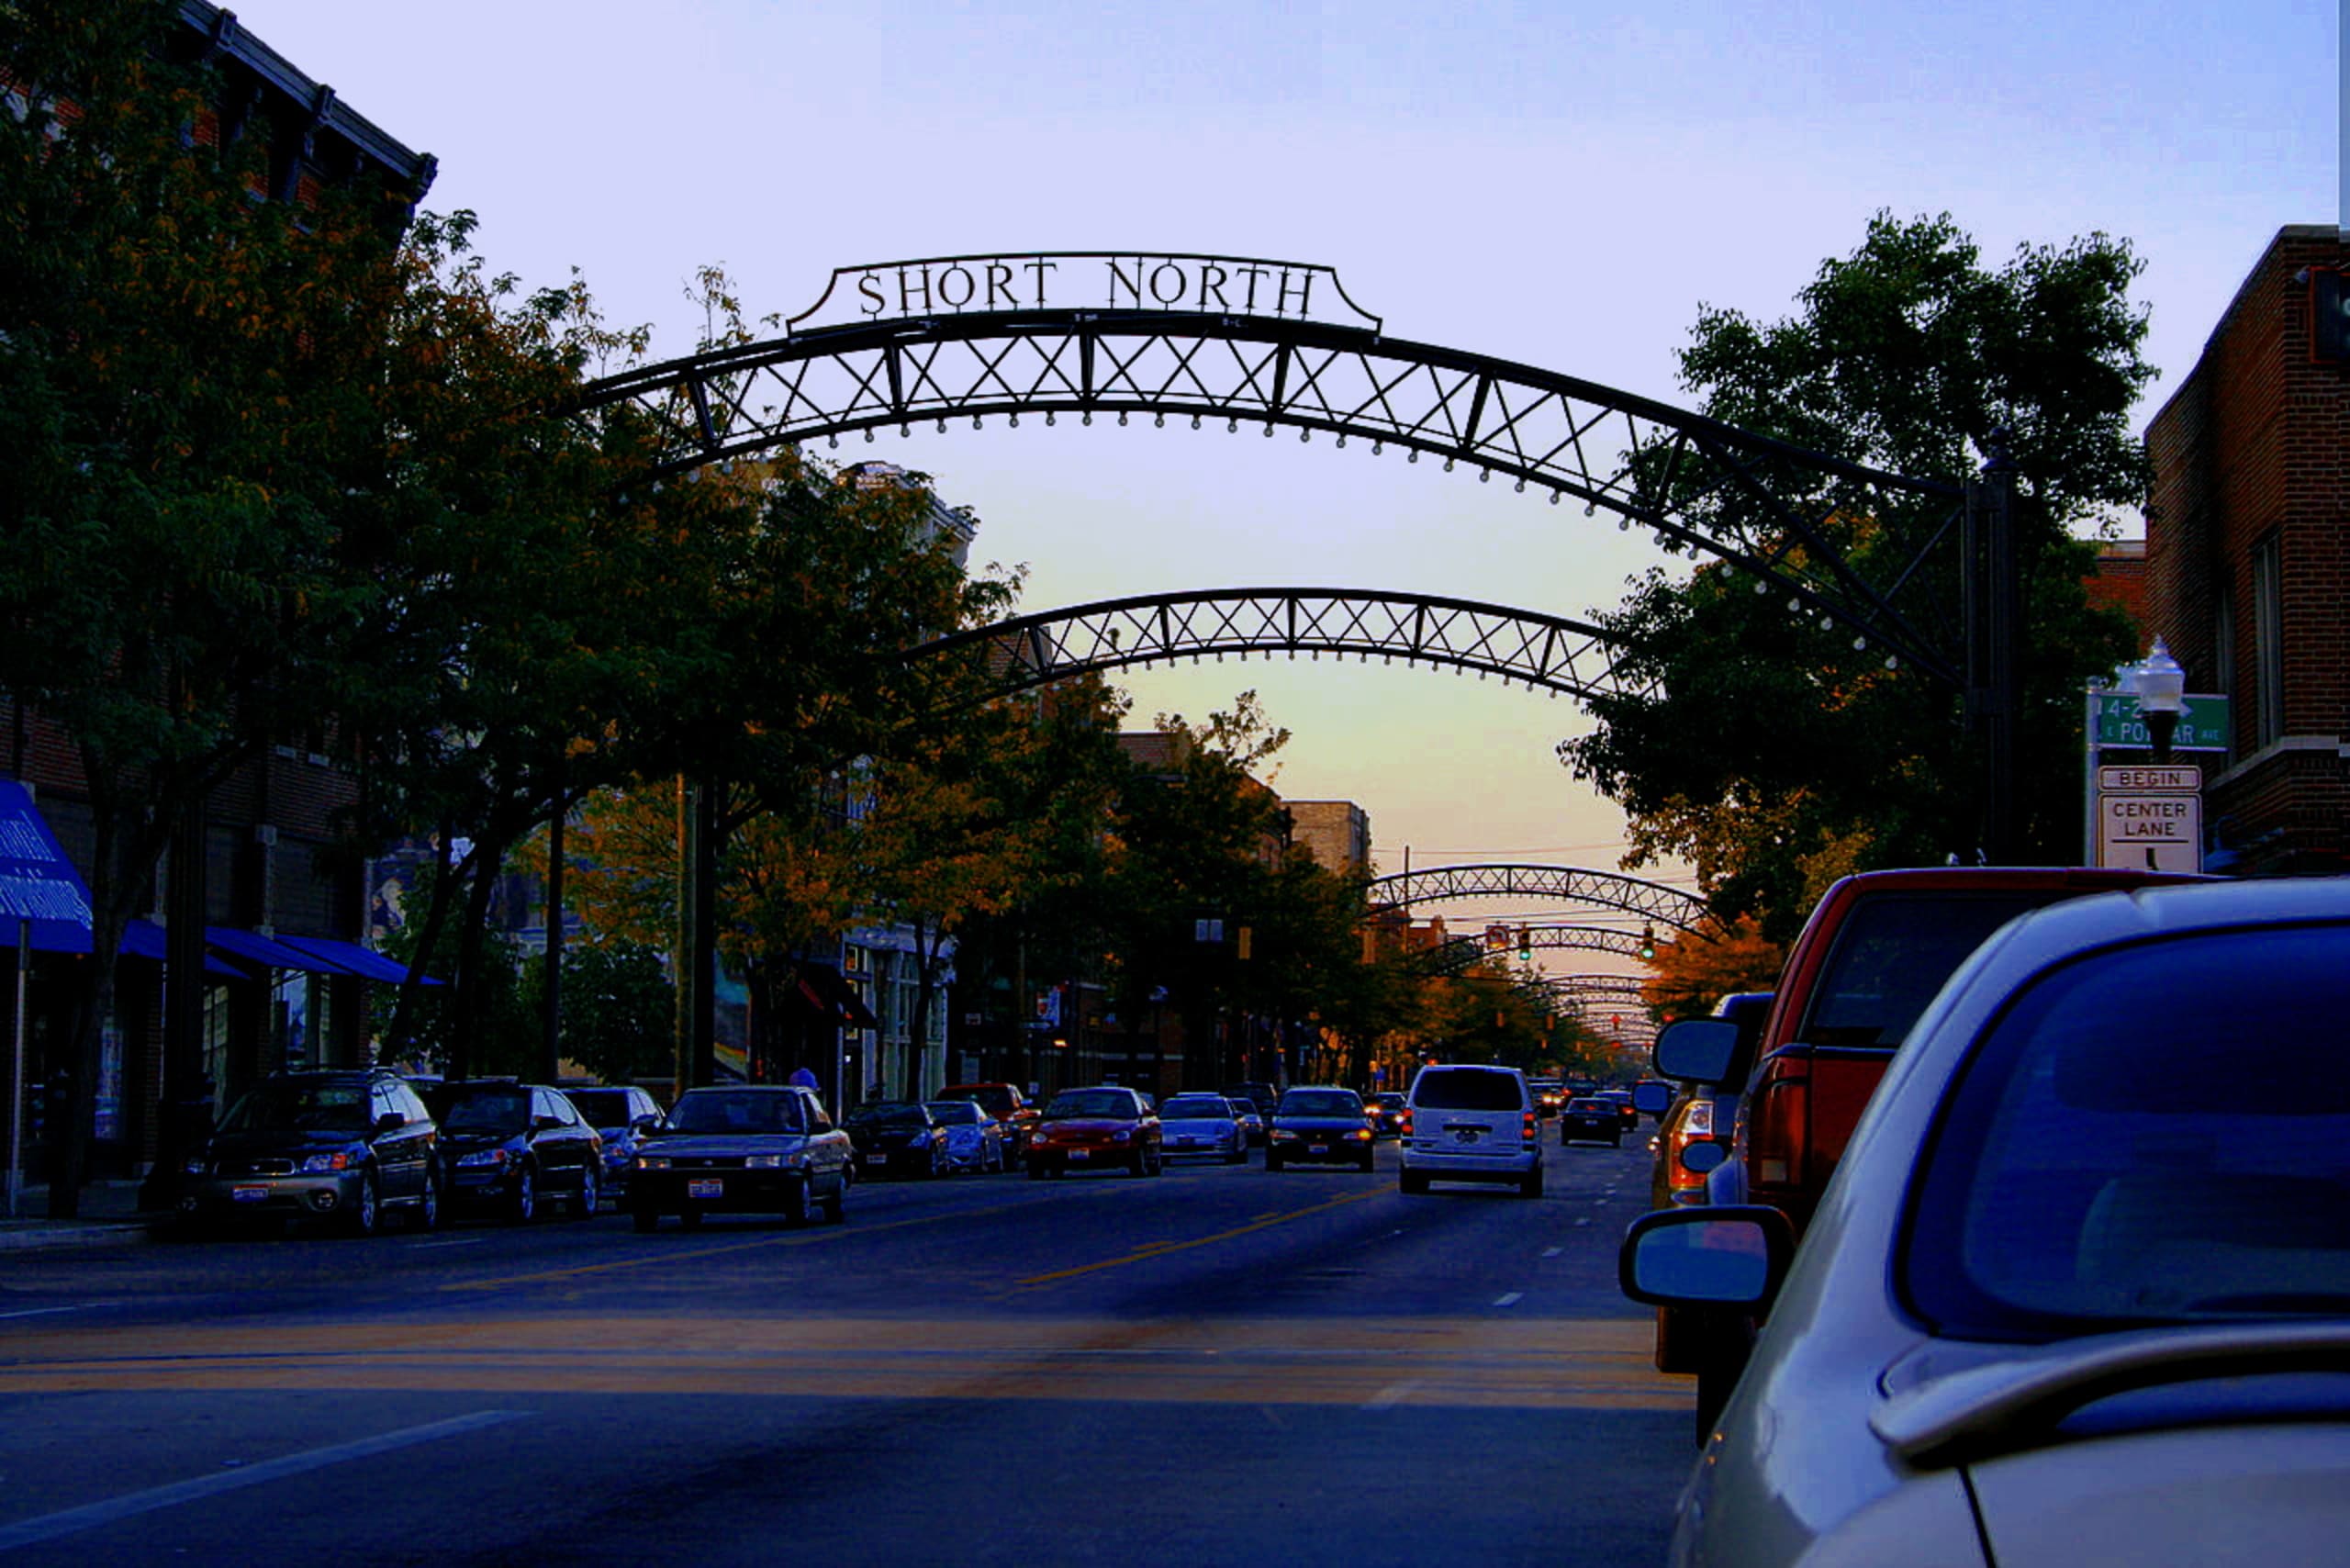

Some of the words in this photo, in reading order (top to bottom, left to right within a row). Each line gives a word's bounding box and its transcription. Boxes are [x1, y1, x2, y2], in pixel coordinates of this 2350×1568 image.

[857, 261, 1058, 315] SHORT
[1105, 260, 1315, 315] NORTH
[2121, 722, 2195, 745] POAR
[2119, 773, 2181, 786] BEGIN
[2114, 803, 2187, 818] CENTER
[2125, 823, 2175, 836] LANE
